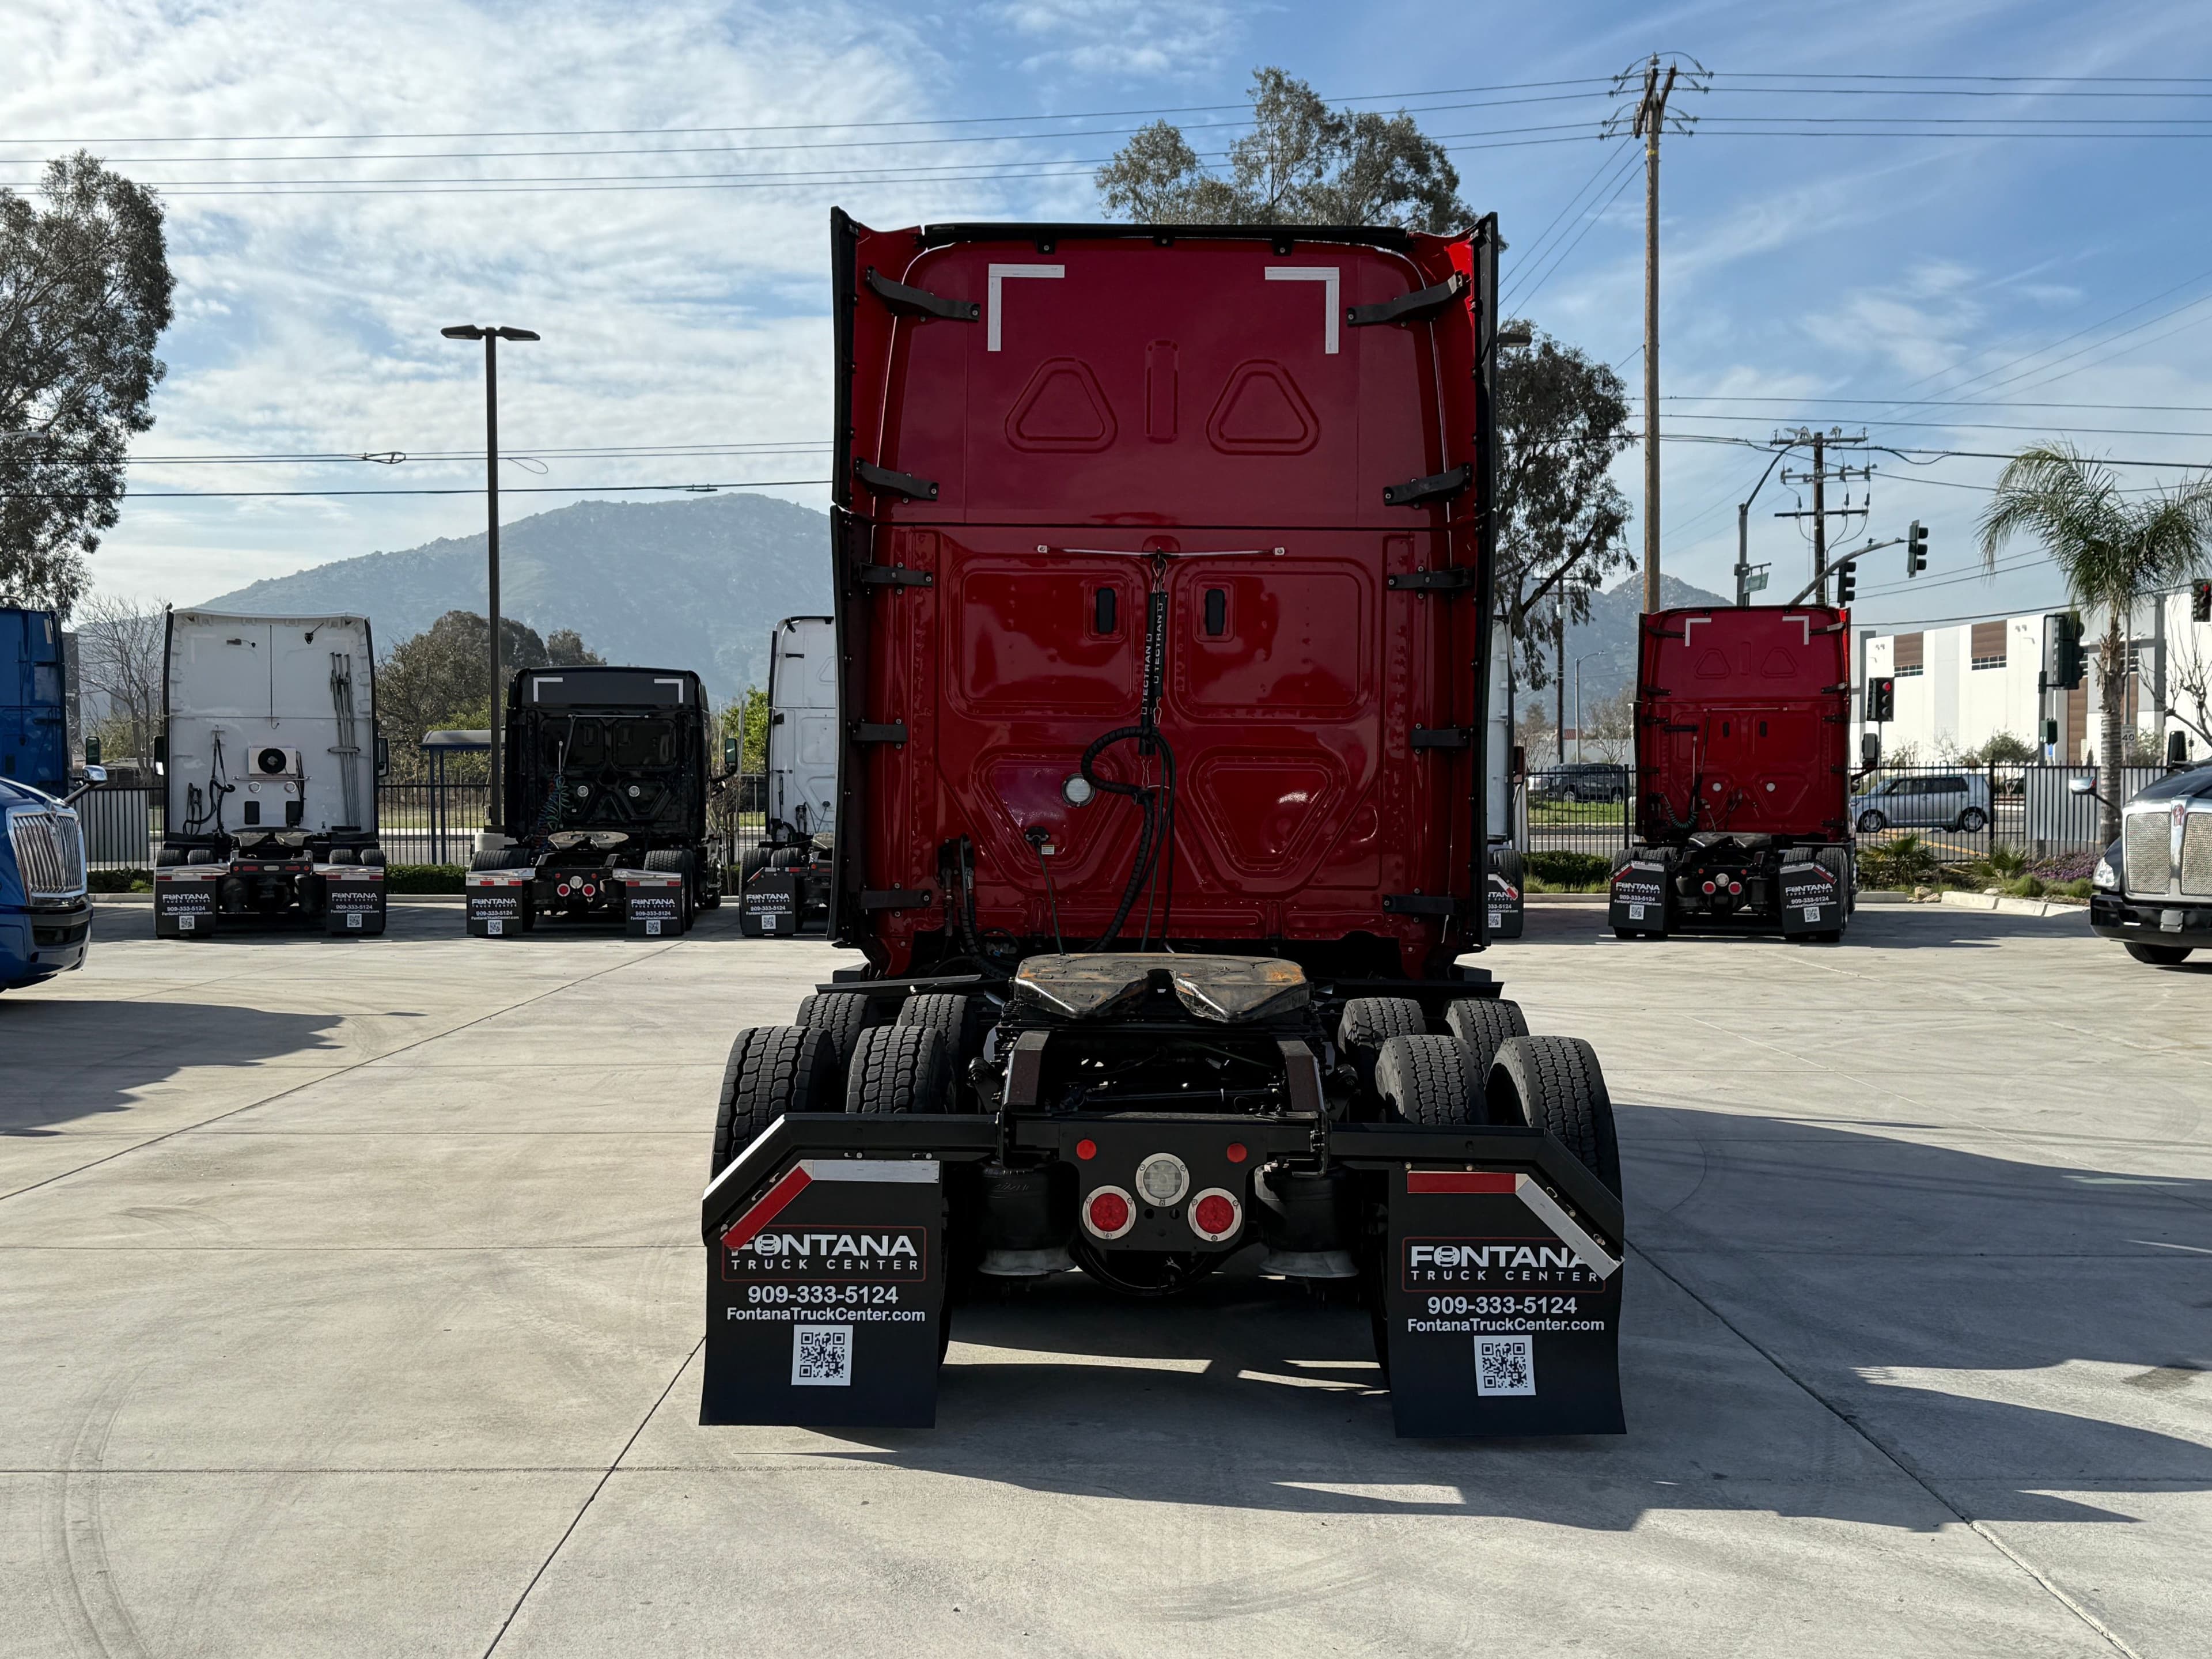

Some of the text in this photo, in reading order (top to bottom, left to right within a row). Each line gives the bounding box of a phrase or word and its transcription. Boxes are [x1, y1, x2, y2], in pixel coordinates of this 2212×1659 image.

[1154, 615, 1162, 672] TECTRAN
[1142, 646, 1152, 703] TECTRAN
[1616, 882, 1660, 891] FONTANA
[1785, 883, 1832, 893] FONTANA
[731, 1259, 918, 1270] TRUCK CENTER
[1411, 1271, 1597, 1282] TRUCK CENTER
[748, 1286, 899, 1304] 909-333-5124
[1427, 1297, 1577, 1314] 909-333-5124
[727, 1307, 926, 1321] FontanaTruckCenter.com
[1407, 1318, 1604, 1332] FontanaTruckCenter.com
